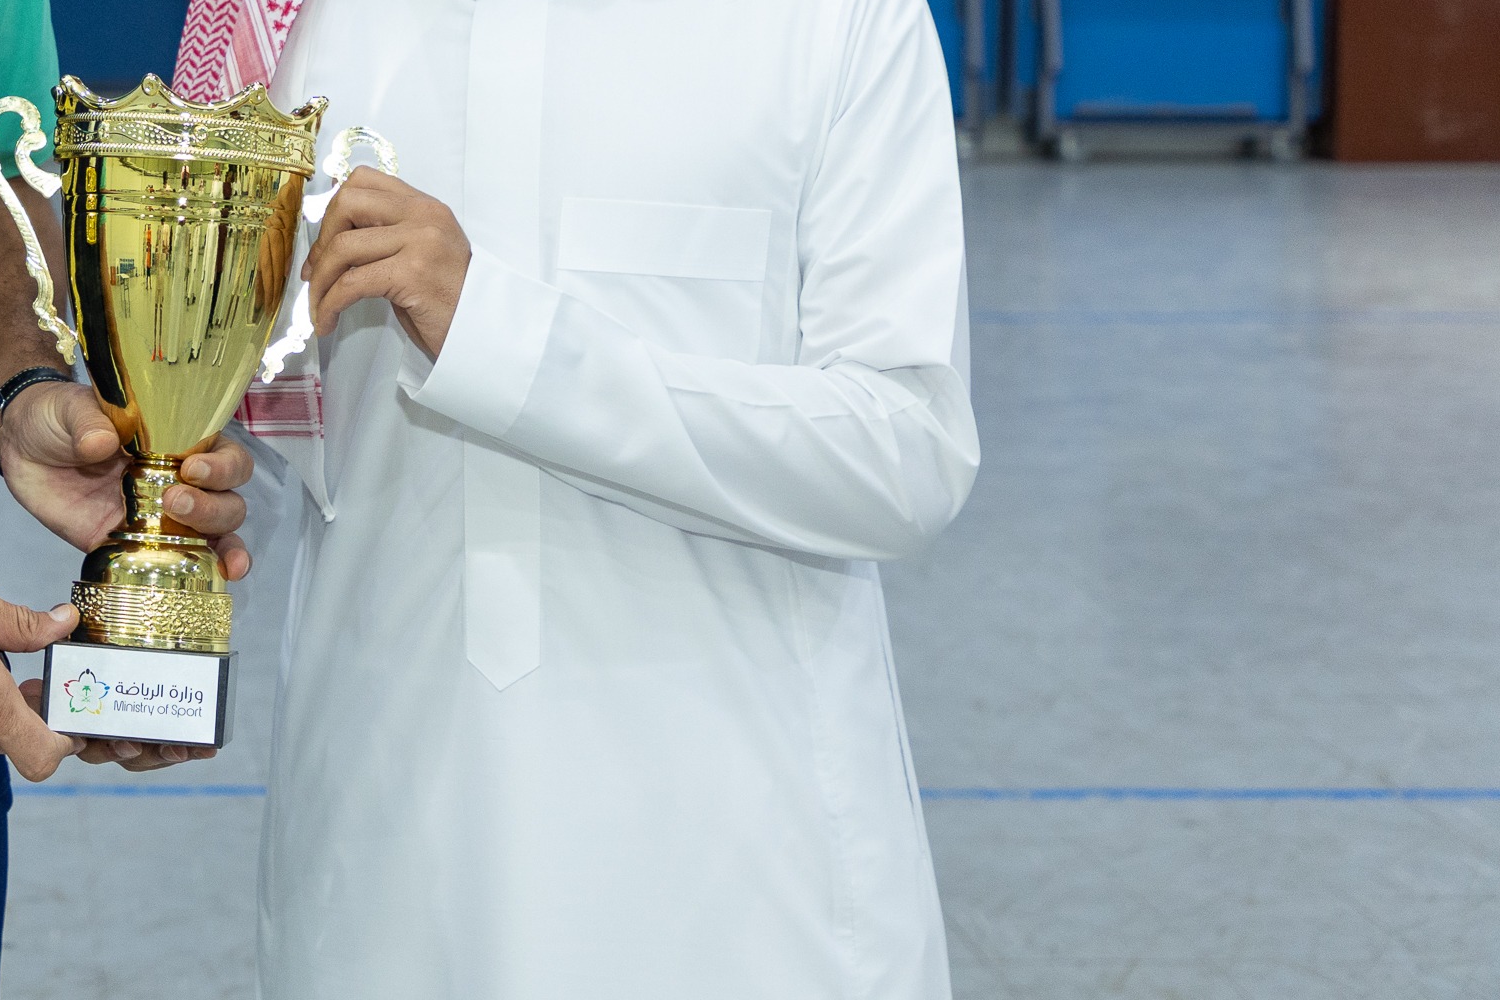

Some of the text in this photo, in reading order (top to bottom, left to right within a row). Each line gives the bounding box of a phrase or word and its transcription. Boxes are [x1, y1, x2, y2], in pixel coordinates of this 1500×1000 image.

[114, 680, 204, 704] وزارة الرياضة
[113, 699, 202, 718] Ministry of Sport
